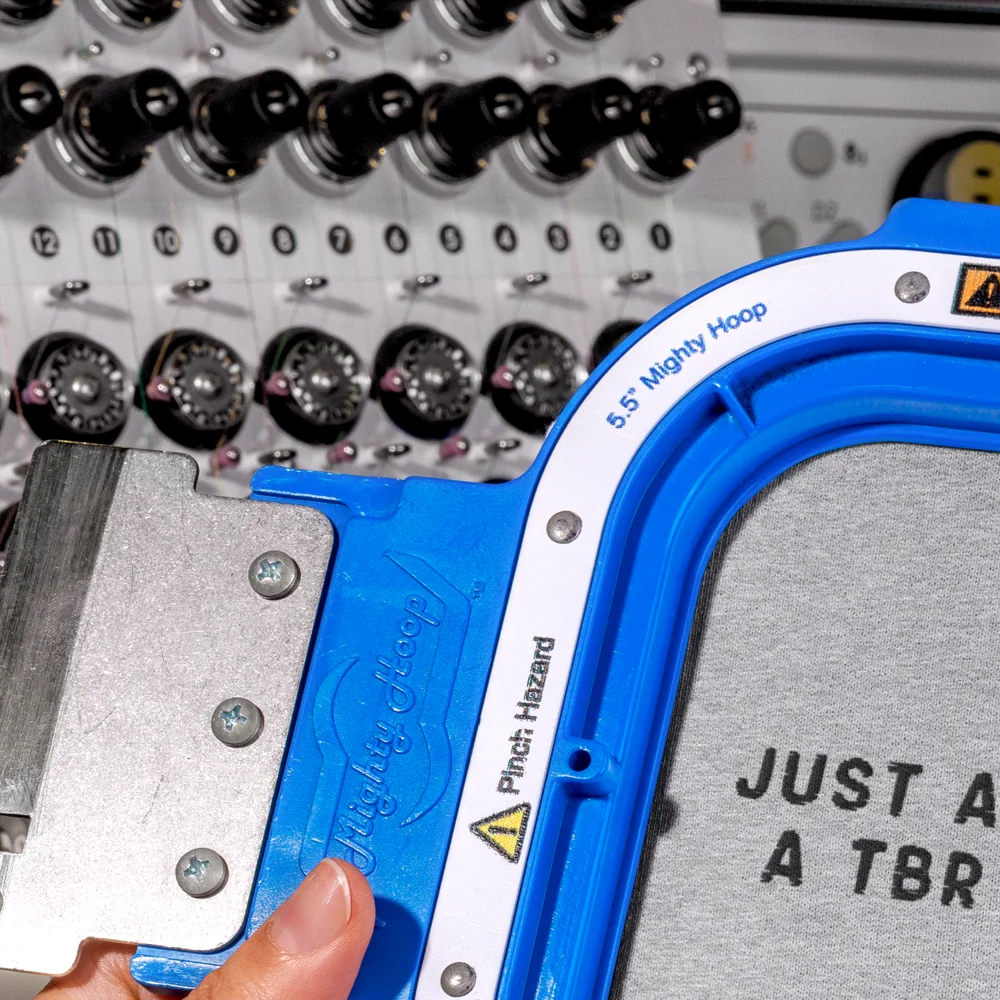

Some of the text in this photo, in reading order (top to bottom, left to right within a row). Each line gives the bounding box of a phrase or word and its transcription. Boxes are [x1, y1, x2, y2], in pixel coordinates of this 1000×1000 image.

[639, 334, 706, 390] Mighty
[707, 302, 768, 339] Hoop
[372, 593, 440, 714] Hoop
[496, 635, 556, 795] Pinch Hazard
[736, 747, 923, 817] JUST
[954, 771, 997, 828] A
[760, 829, 803, 887] A
[852, 837, 988, 910] TBR
